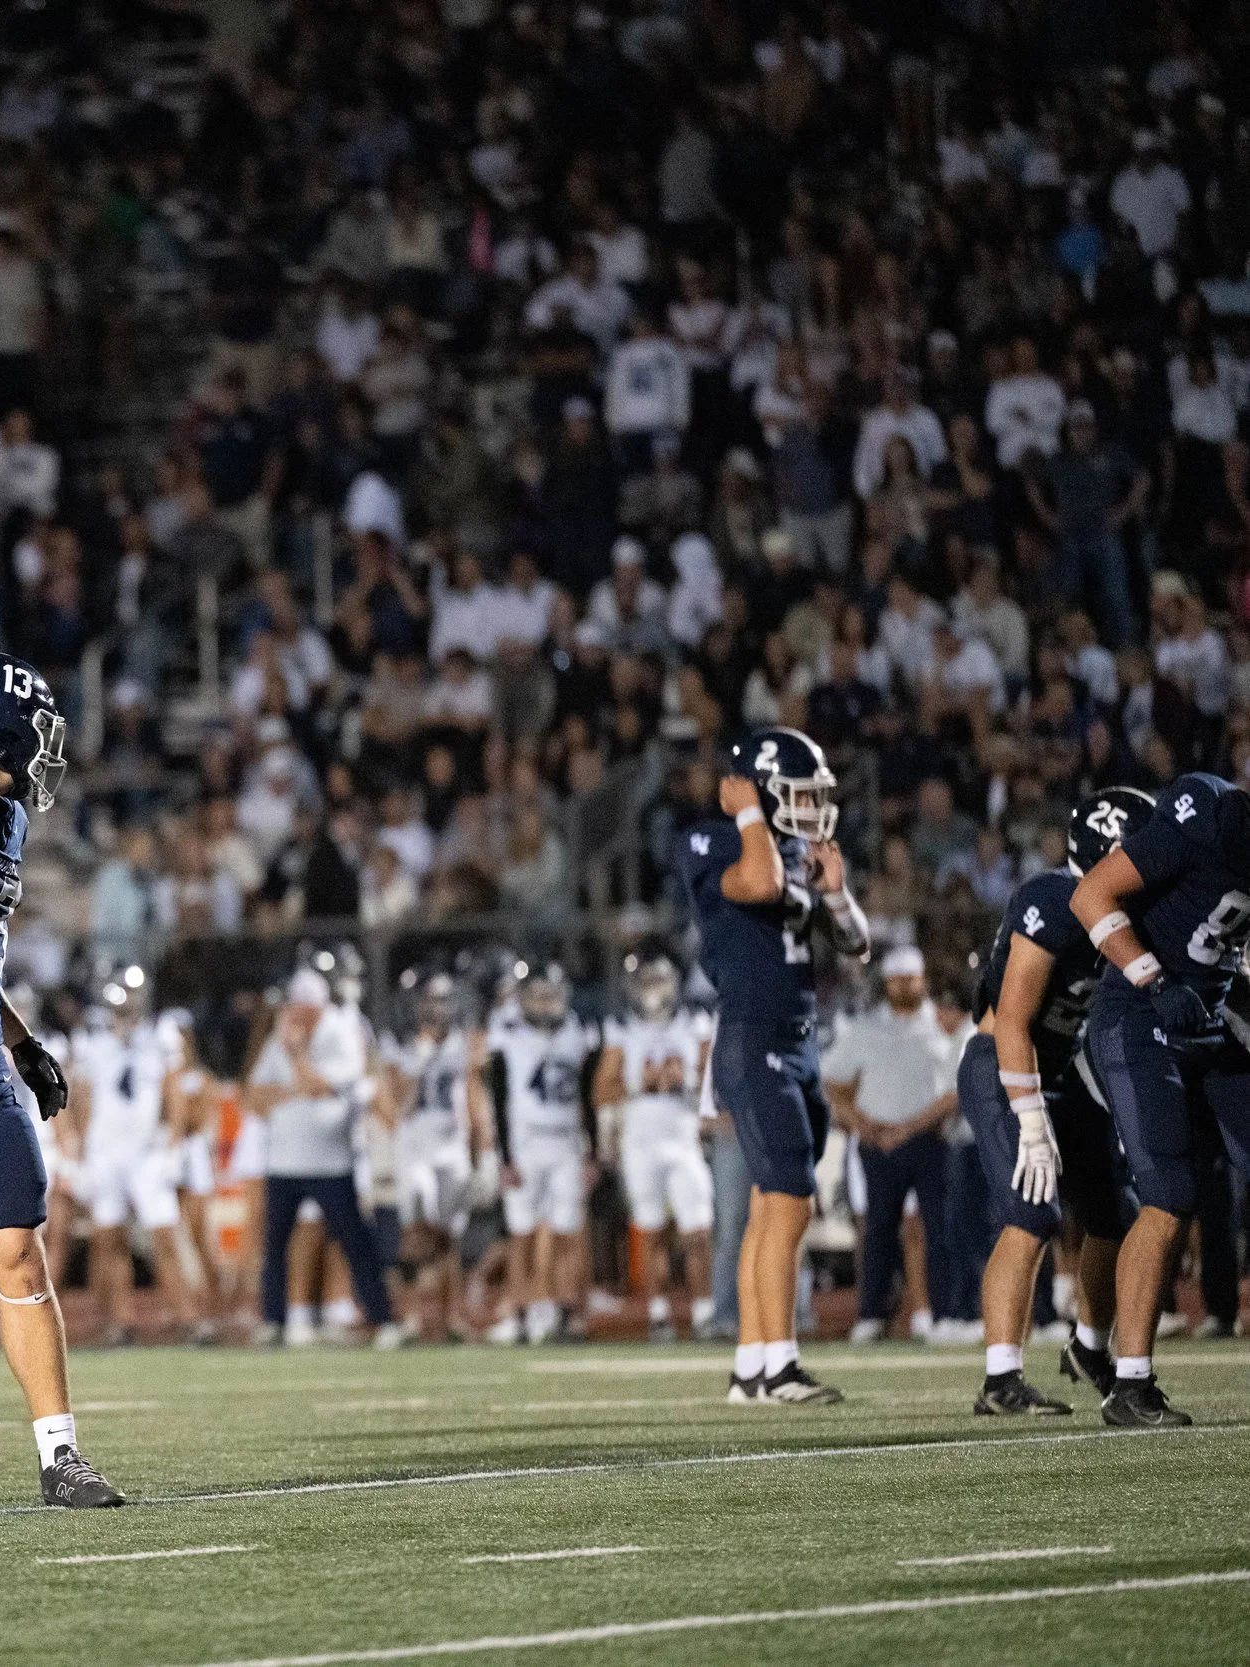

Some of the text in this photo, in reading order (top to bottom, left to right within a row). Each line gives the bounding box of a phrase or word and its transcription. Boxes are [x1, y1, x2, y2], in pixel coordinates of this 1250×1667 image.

[3, 664, 33, 699] 13
[755, 740, 779, 771] 2
[1086, 800, 1128, 839] 25
[1174, 793, 1197, 824] SV
